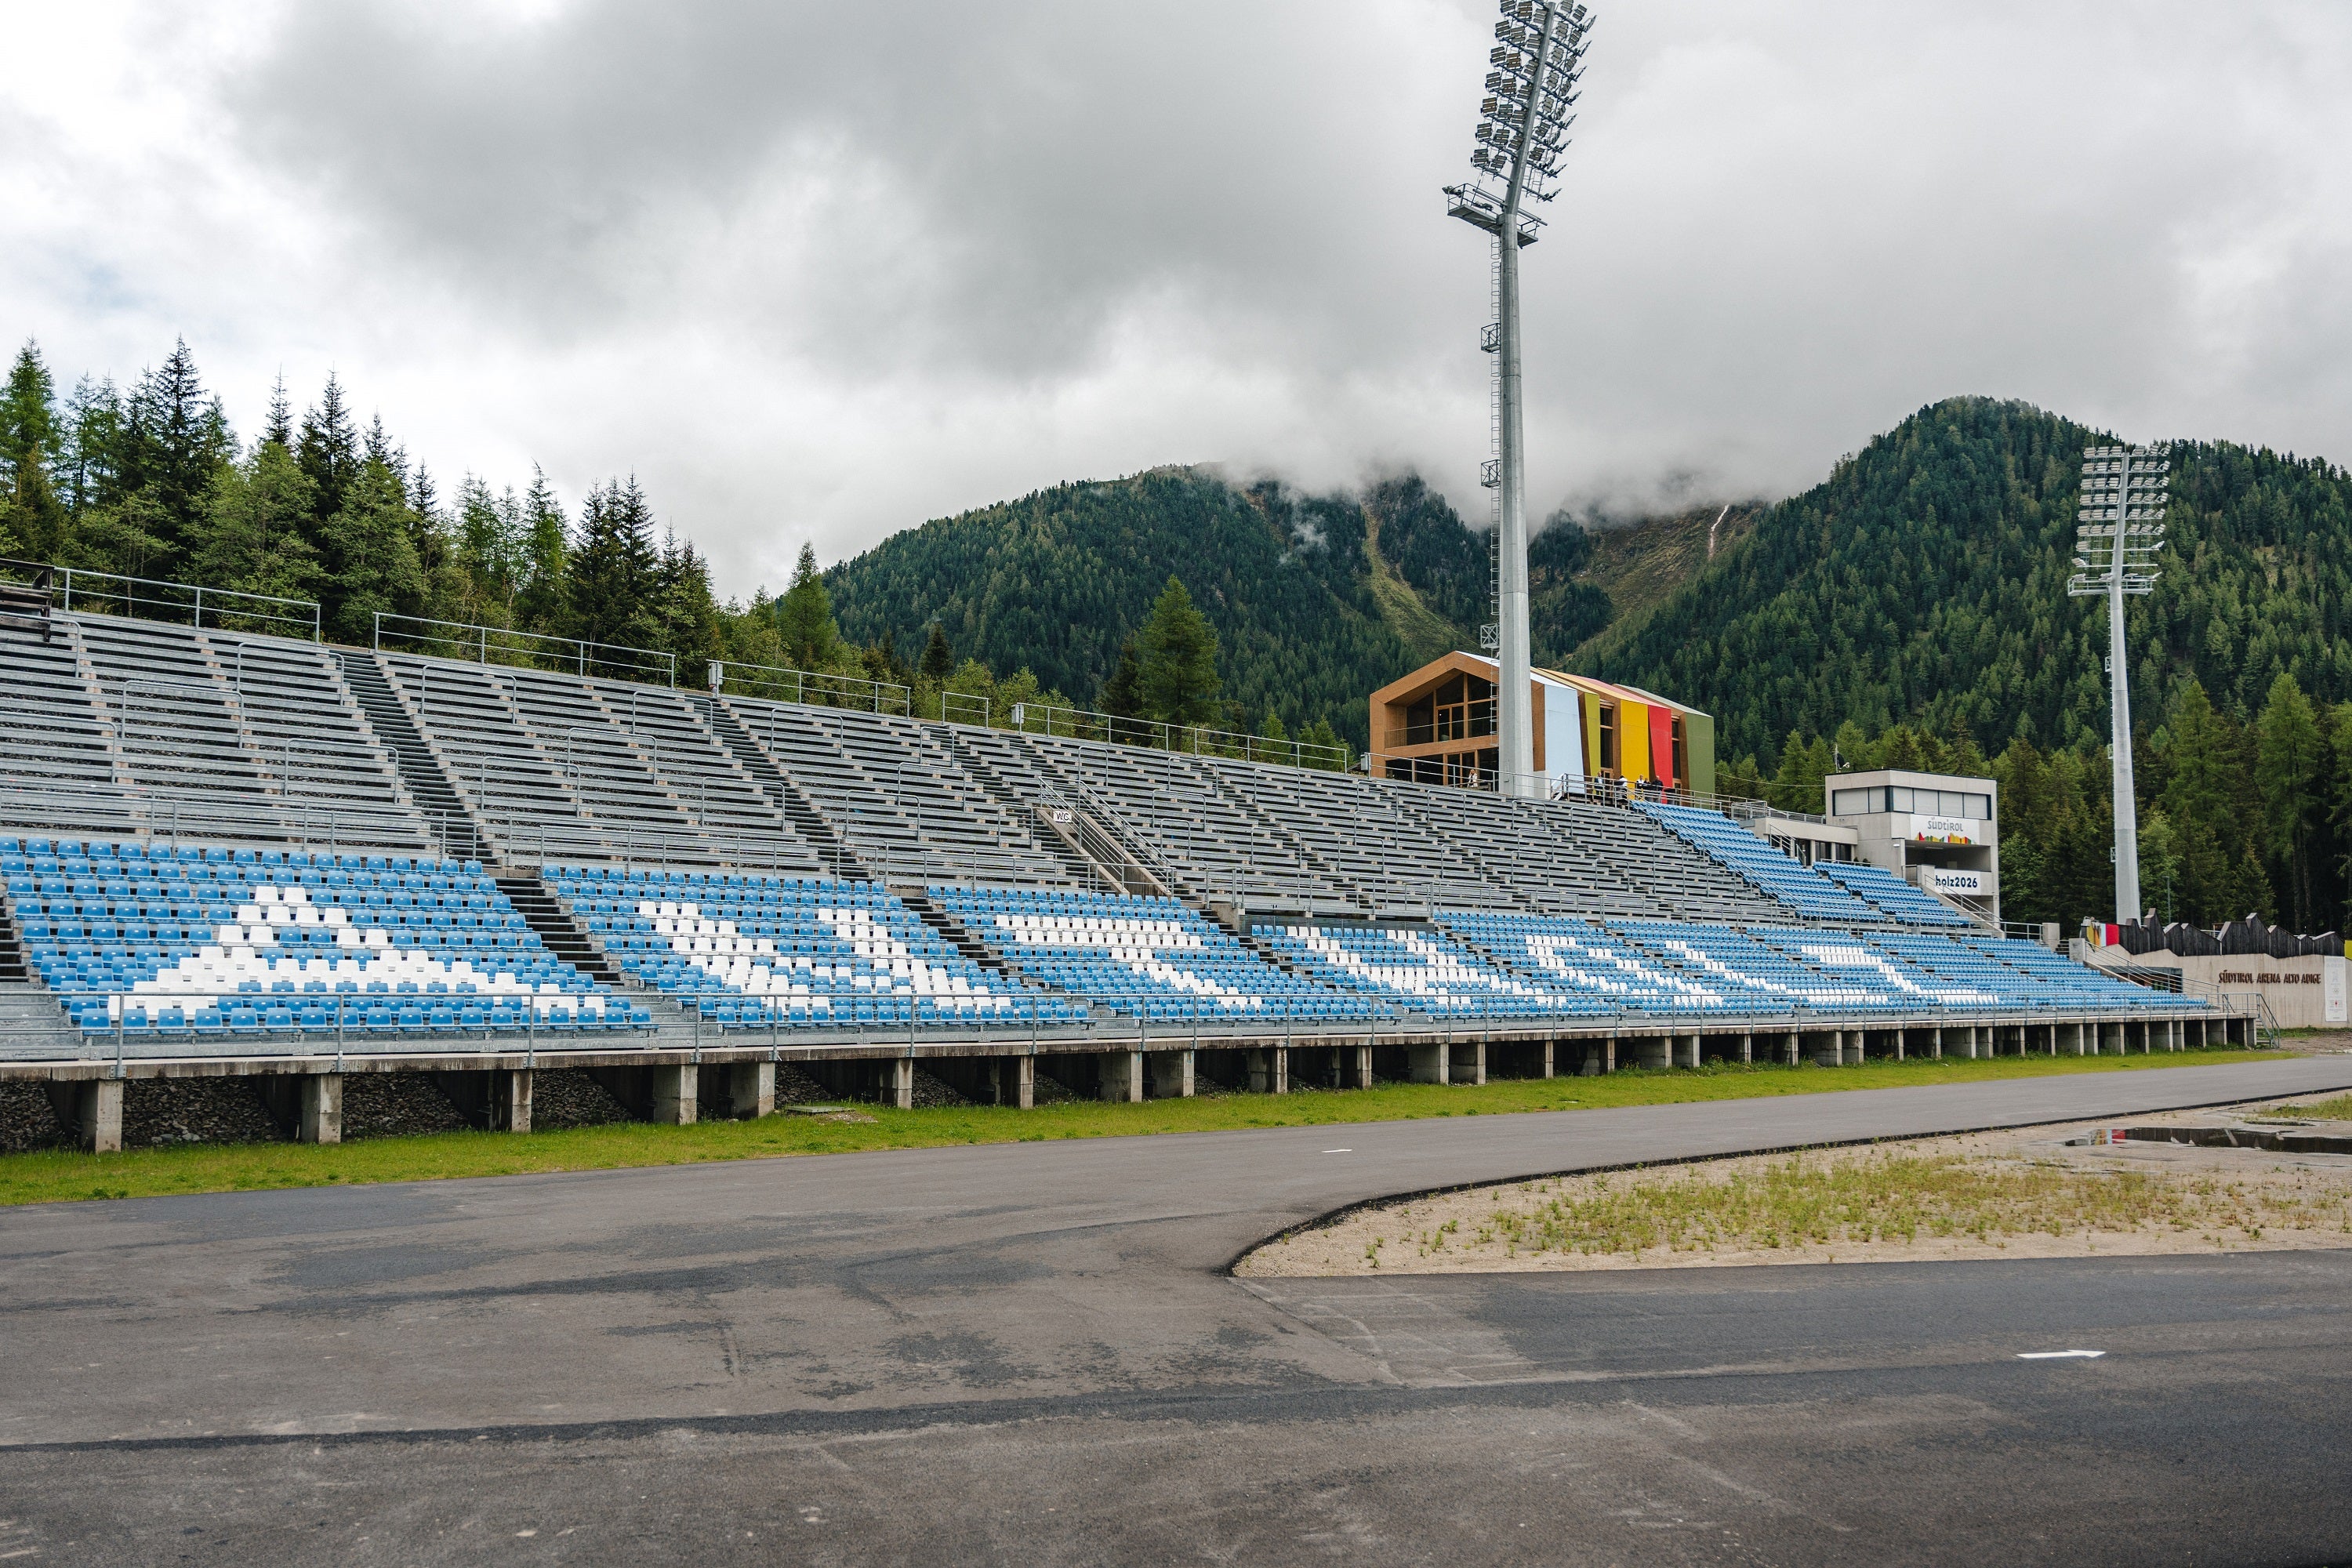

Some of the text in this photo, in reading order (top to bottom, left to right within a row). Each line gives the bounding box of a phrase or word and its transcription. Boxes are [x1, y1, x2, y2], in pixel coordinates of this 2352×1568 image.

[1057, 812, 1069, 821] WC
[1935, 874, 1978, 888] holz2026
[2256, 972, 2281, 984] ARENA
[2284, 973, 2299, 985] ALTO
[2300, 973, 2321, 985] ADIGE
